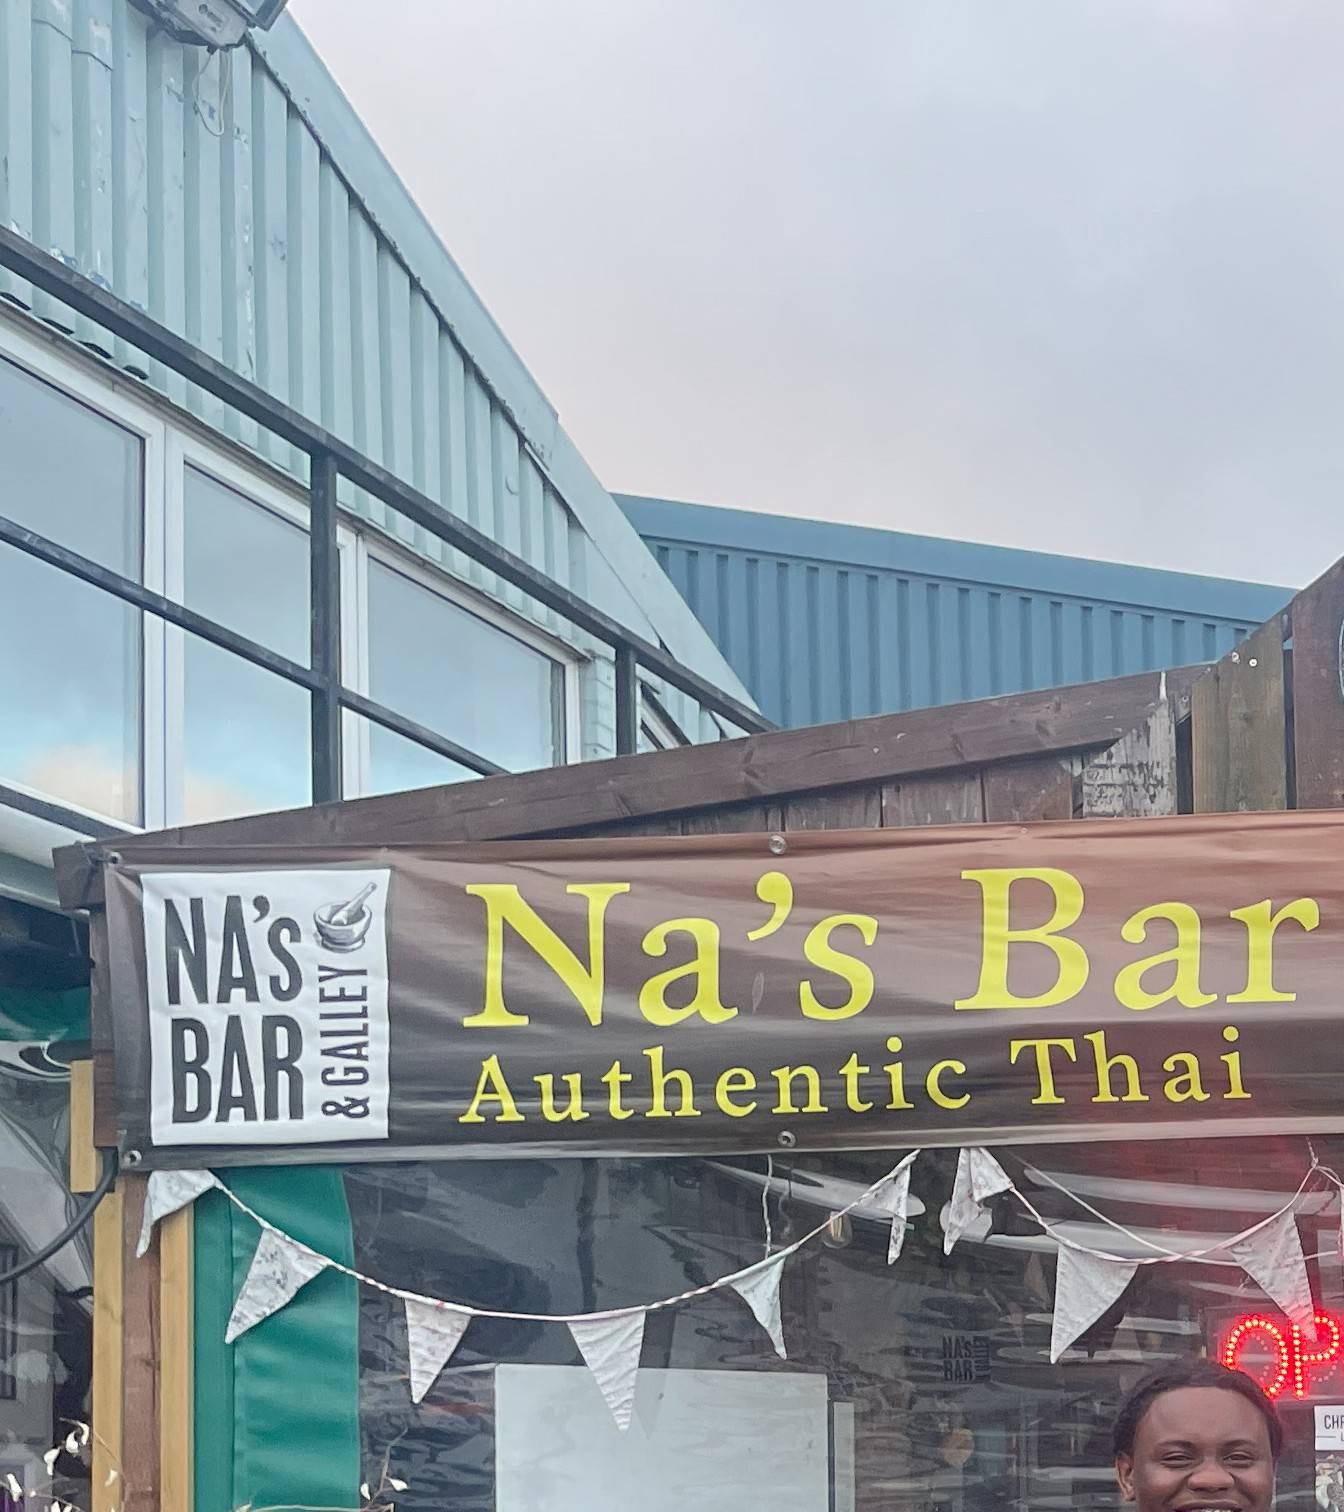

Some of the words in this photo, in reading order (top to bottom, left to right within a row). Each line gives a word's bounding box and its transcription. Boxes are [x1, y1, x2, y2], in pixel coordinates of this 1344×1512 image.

[463, 871, 879, 1027] Na's
[954, 867, 1321, 1011] Bar
[170, 1015, 304, 1123] BAR
[319, 964, 370, 1090] GALLEY
[458, 1036, 972, 1123] Authentic
[1009, 1025, 1253, 1105] Thai
[321, 1096, 370, 1119] &
